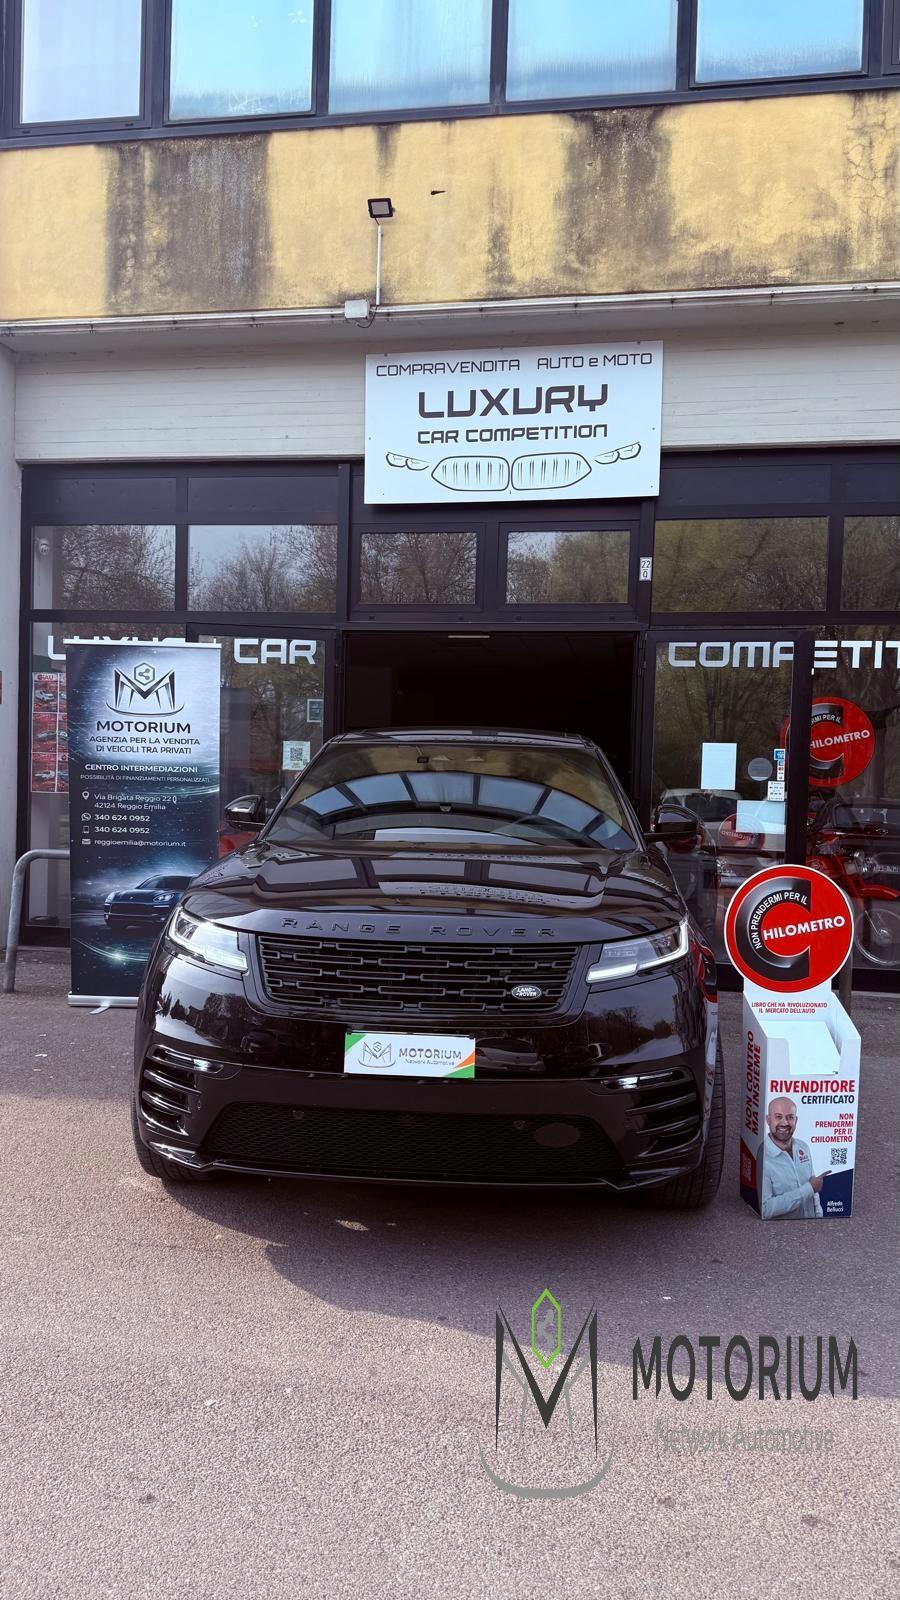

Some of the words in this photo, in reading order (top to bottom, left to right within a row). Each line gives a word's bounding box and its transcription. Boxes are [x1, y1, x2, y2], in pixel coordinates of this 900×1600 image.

[376, 359, 520, 377] COMPRAVENDITA
[537, 356, 584, 370] AUTO
[588, 356, 598, 368] e
[602, 352, 652, 366] MOTO
[418, 384, 608, 419] LUXURY
[417, 430, 458, 444] CAR
[466, 424, 608, 442] COMPETITION
[641, 560, 650, 568] 22
[234, 638, 316, 664] CAR
[96, 720, 191, 734] MOTORIUM
[120, 765, 198, 773] INTERMEDIAZIONI
[107, 794, 134, 802] Brigata
[136, 795, 160, 803] Reggio
[94, 839, 186, 847] reggioemilia@motorium.it
[784, 892, 800, 901] PER
[801, 895, 808, 905] IL
[751, 892, 782, 930] PRENDERMI
[281, 917, 400, 934] RANGE
[429, 926, 555, 937] ROVER
[751, 931, 762, 950] NON
[399, 1048, 462, 1059] MOTORIUM
[752, 1045, 760, 1108] INSIEME
[770, 1079, 855, 1093] RIVENDITORE
[801, 1095, 855, 1105] CERTIFICATO
[746, 1097, 754, 1130] NON
[752, 1111, 759, 1136] MA
